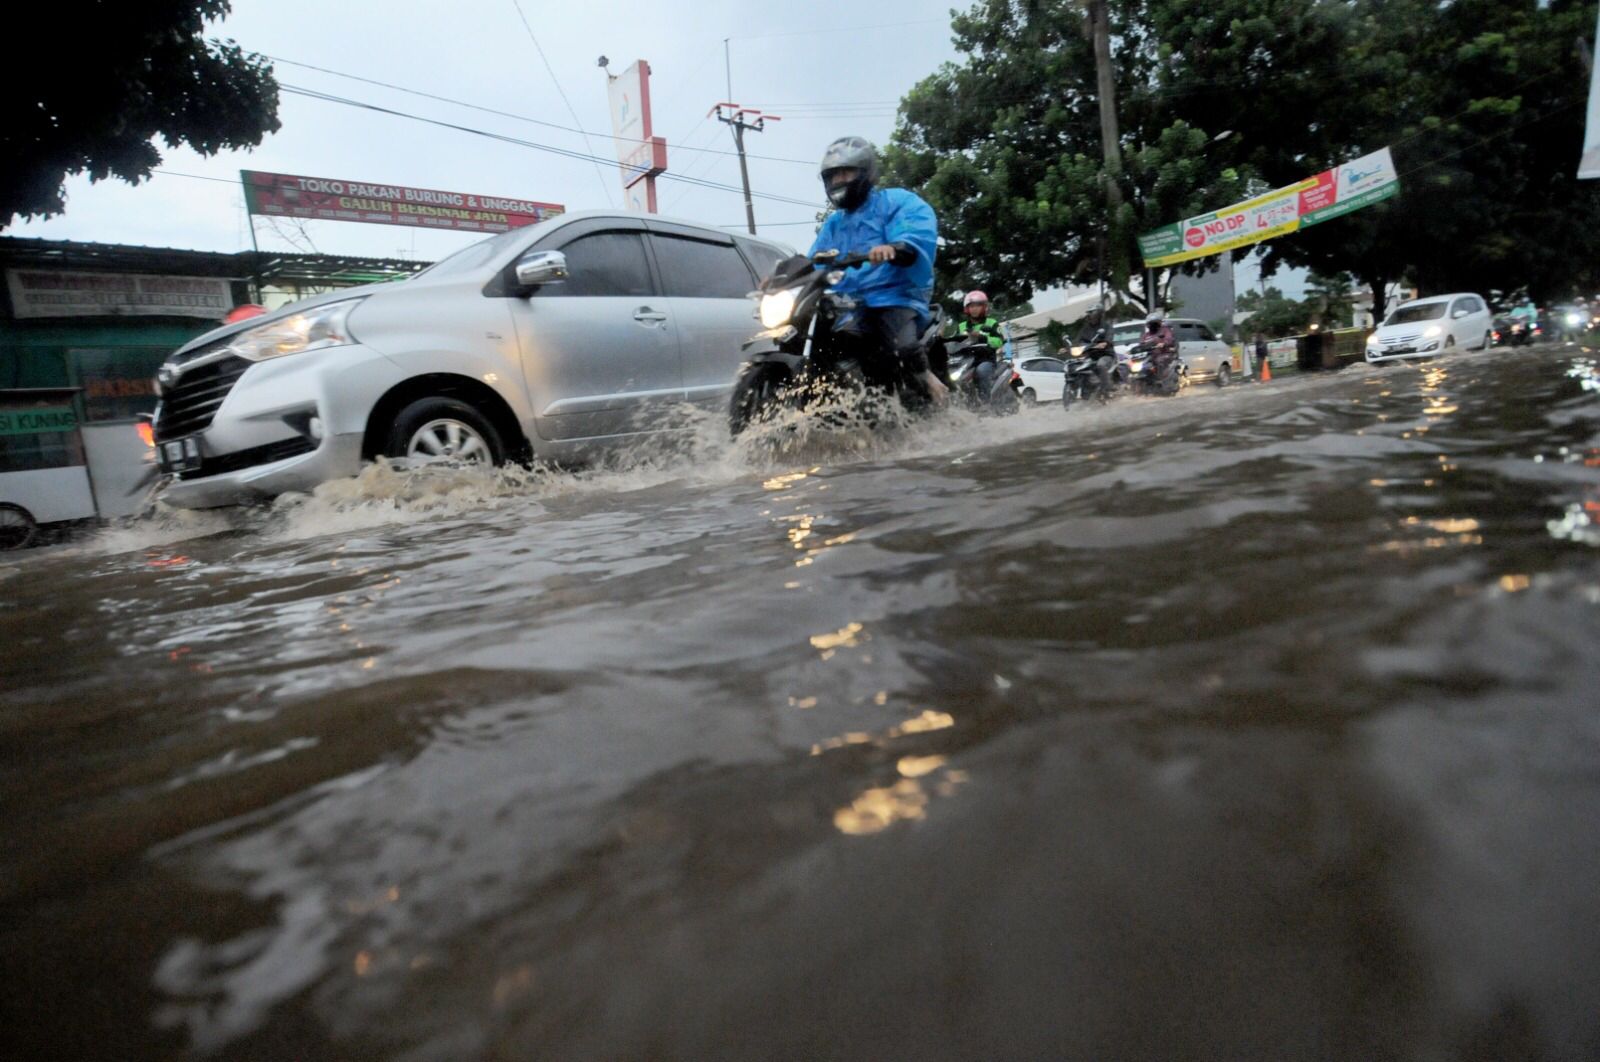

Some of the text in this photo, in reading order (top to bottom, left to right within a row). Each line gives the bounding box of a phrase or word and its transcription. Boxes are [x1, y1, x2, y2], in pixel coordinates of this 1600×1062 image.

[298, 178, 534, 213] TOKO PAKAN BURUNG & UNGGAS
[340, 197, 392, 211] GALUH
[474, 211, 508, 222] JAYA
[1204, 221, 1225, 236] NO
[1226, 214, 1246, 230] DP
[1257, 214, 1268, 228] 4
[17, 412, 76, 429] KUNING
